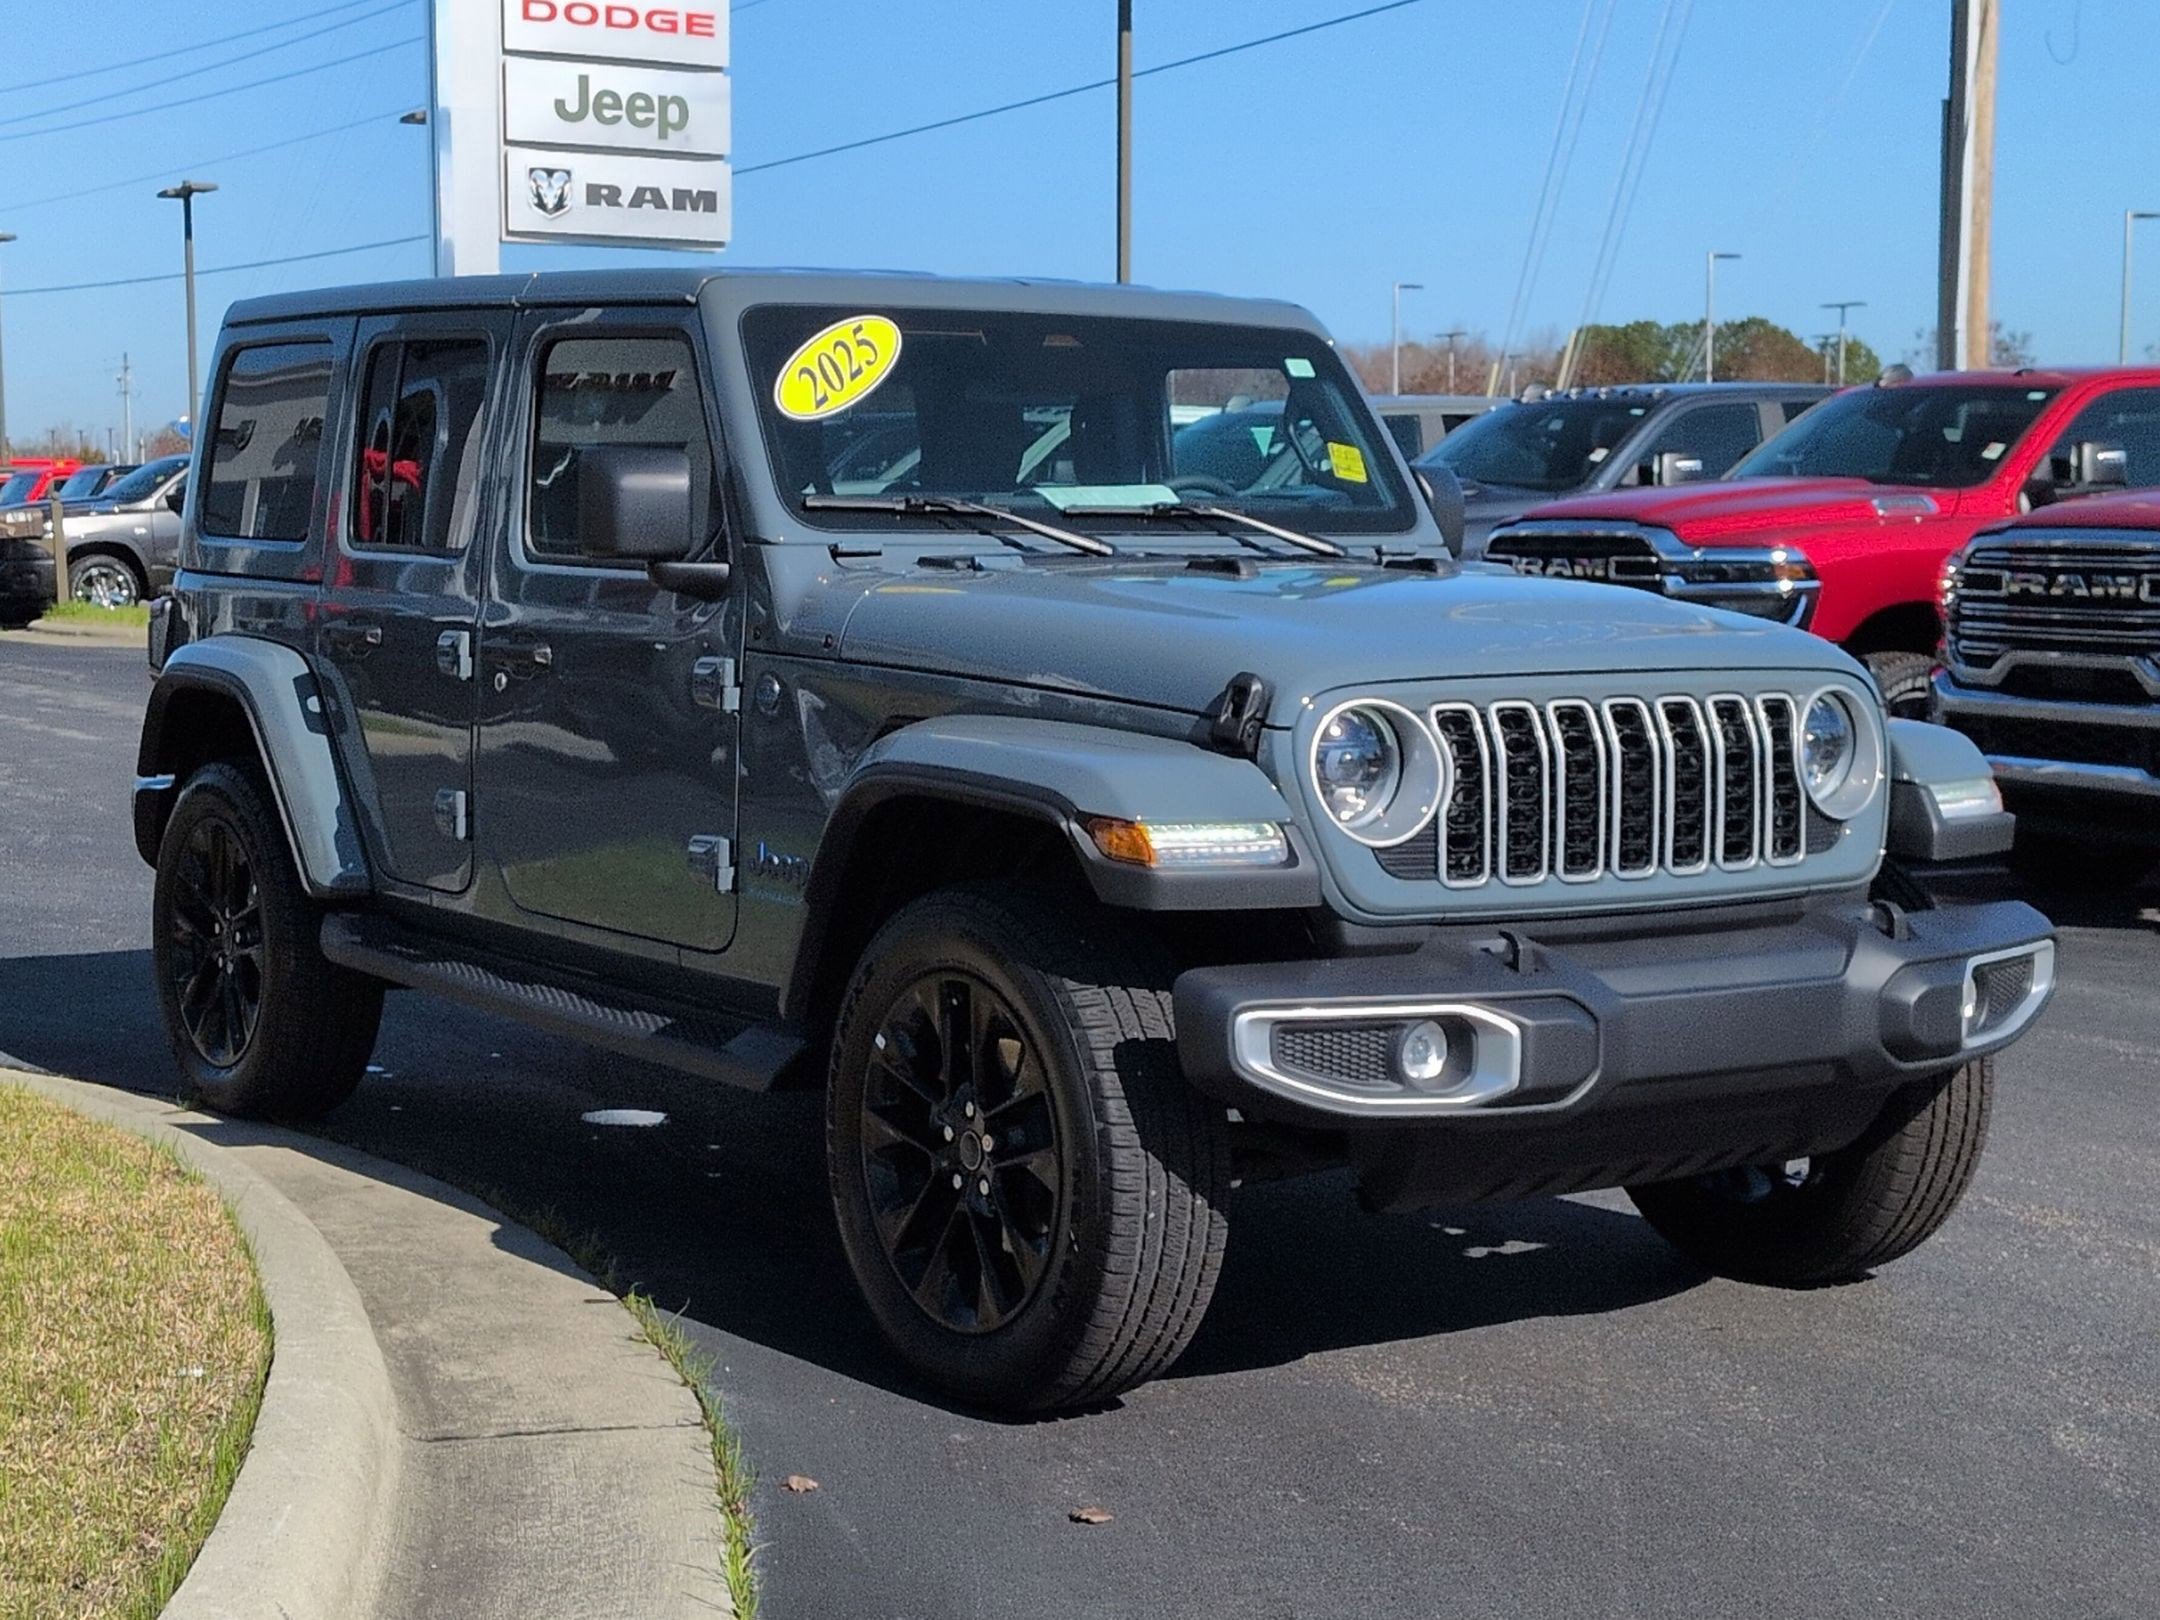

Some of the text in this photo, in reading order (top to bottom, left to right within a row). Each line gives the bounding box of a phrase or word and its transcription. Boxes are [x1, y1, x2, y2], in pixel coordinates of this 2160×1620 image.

[522, 0, 715, 38] DODGE
[554, 74, 690, 140] Jeep
[585, 183, 718, 213] RAM
[798, 323, 878, 410] 2025
[1517, 556, 1607, 577] RAM
[2008, 572, 2137, 598] RAM
